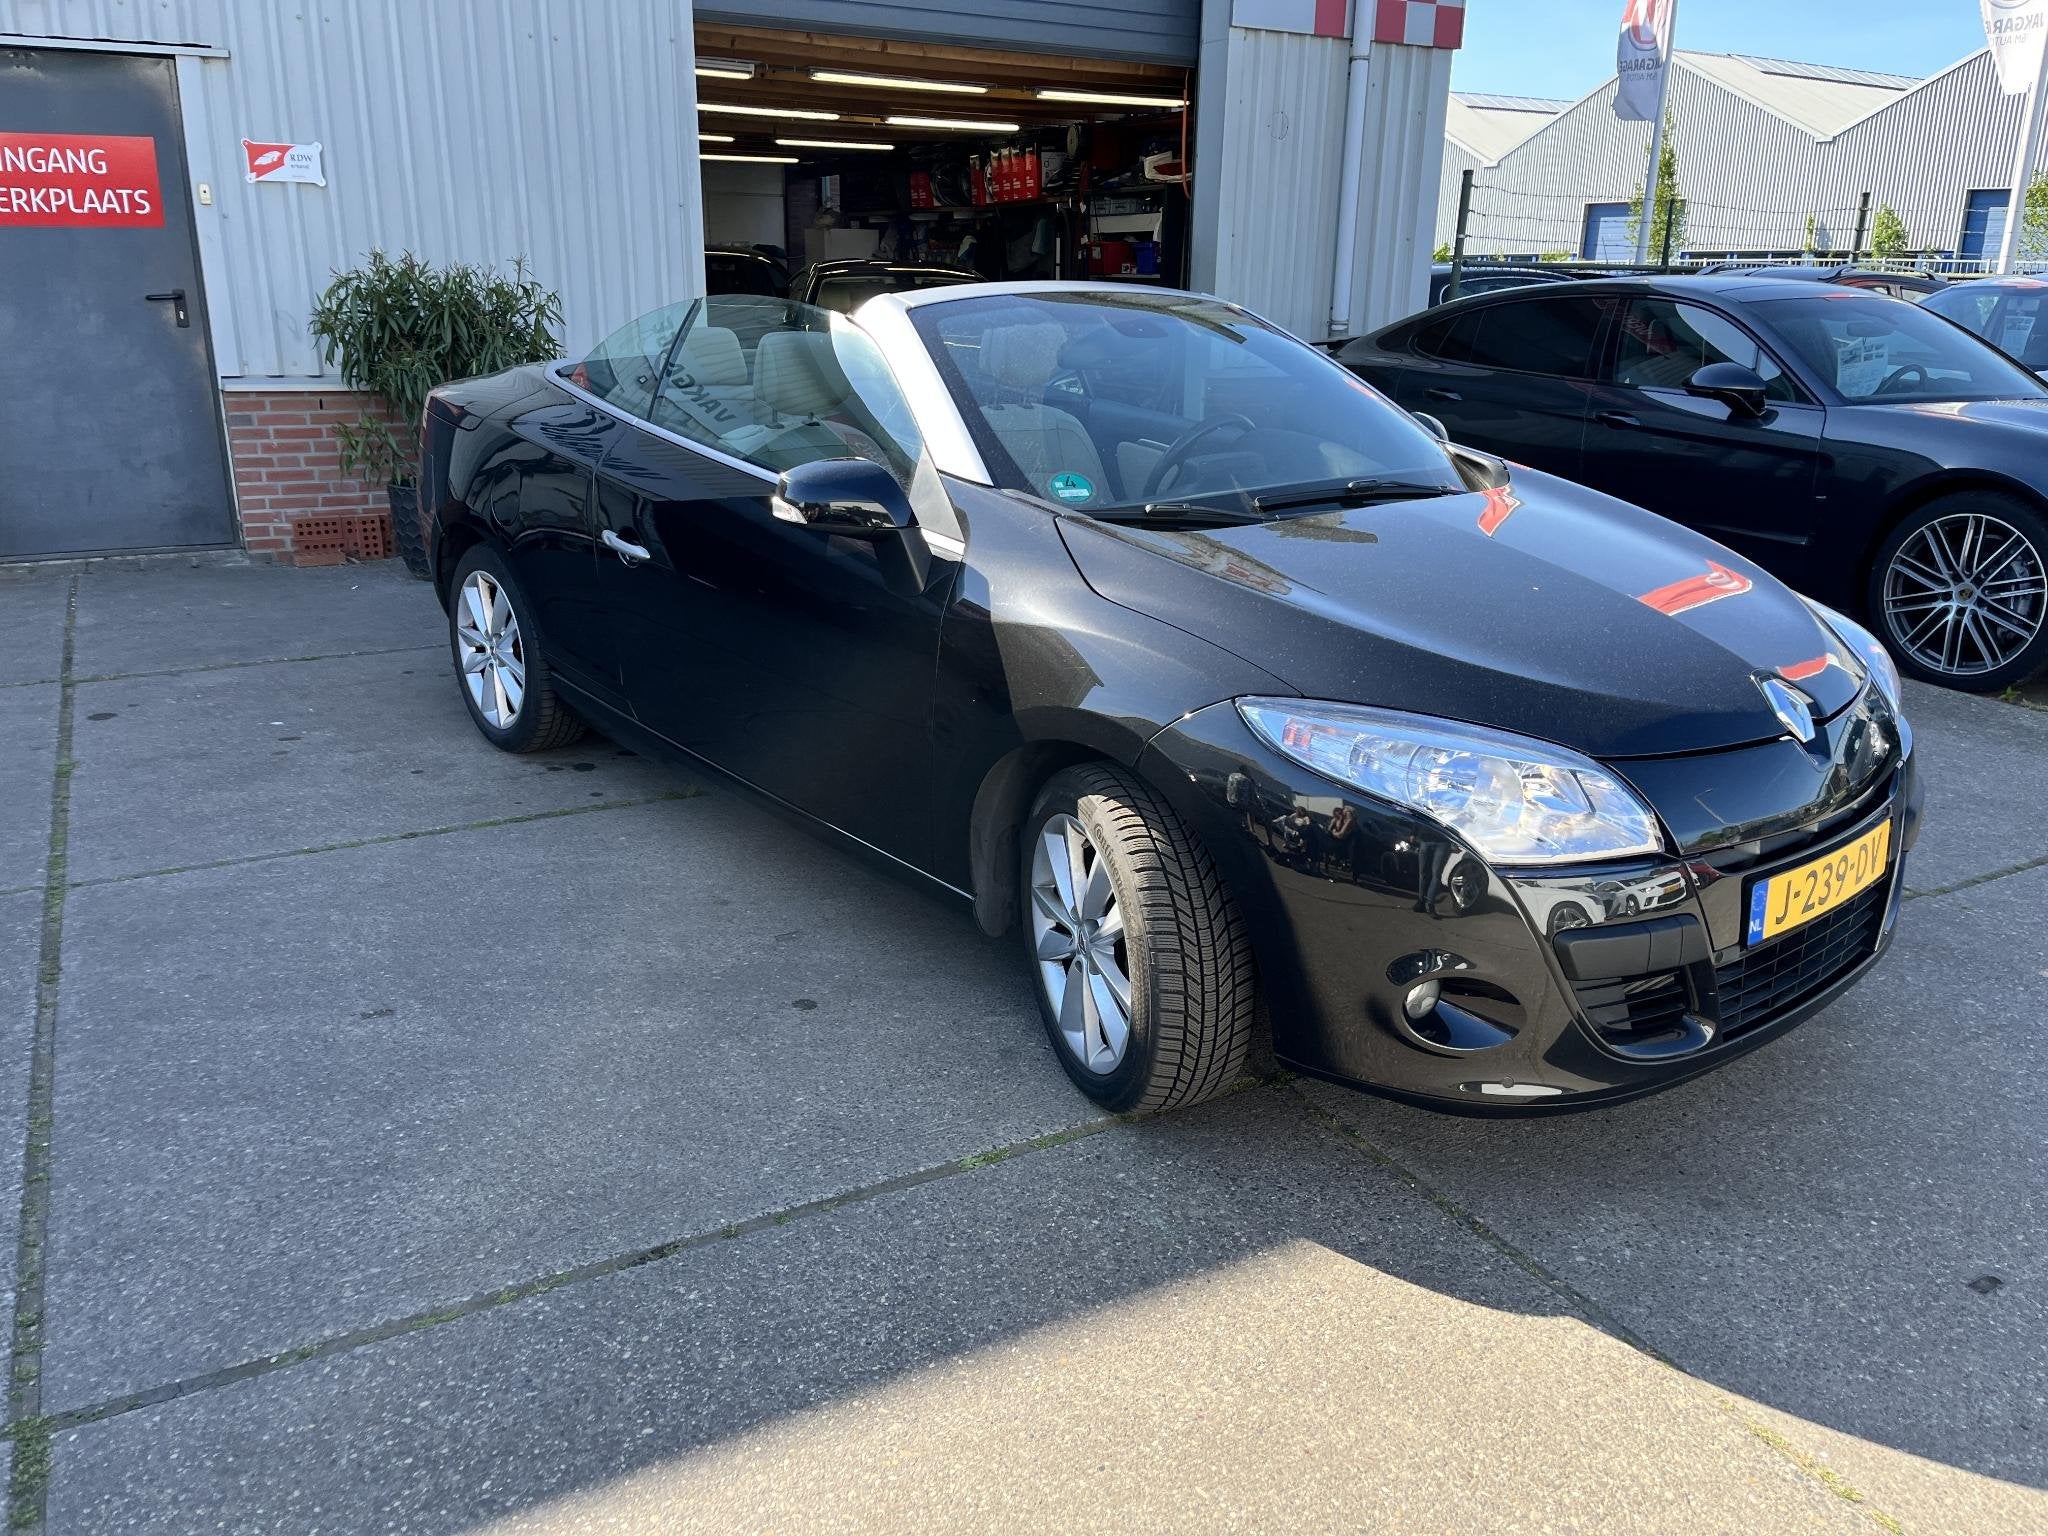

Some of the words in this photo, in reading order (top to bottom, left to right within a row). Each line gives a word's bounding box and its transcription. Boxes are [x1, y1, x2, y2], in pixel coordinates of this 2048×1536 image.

[290, 153, 312, 162] RDW
[1775, 831, 1882, 925] J-239-DV
[1750, 919, 1762, 934] NL
